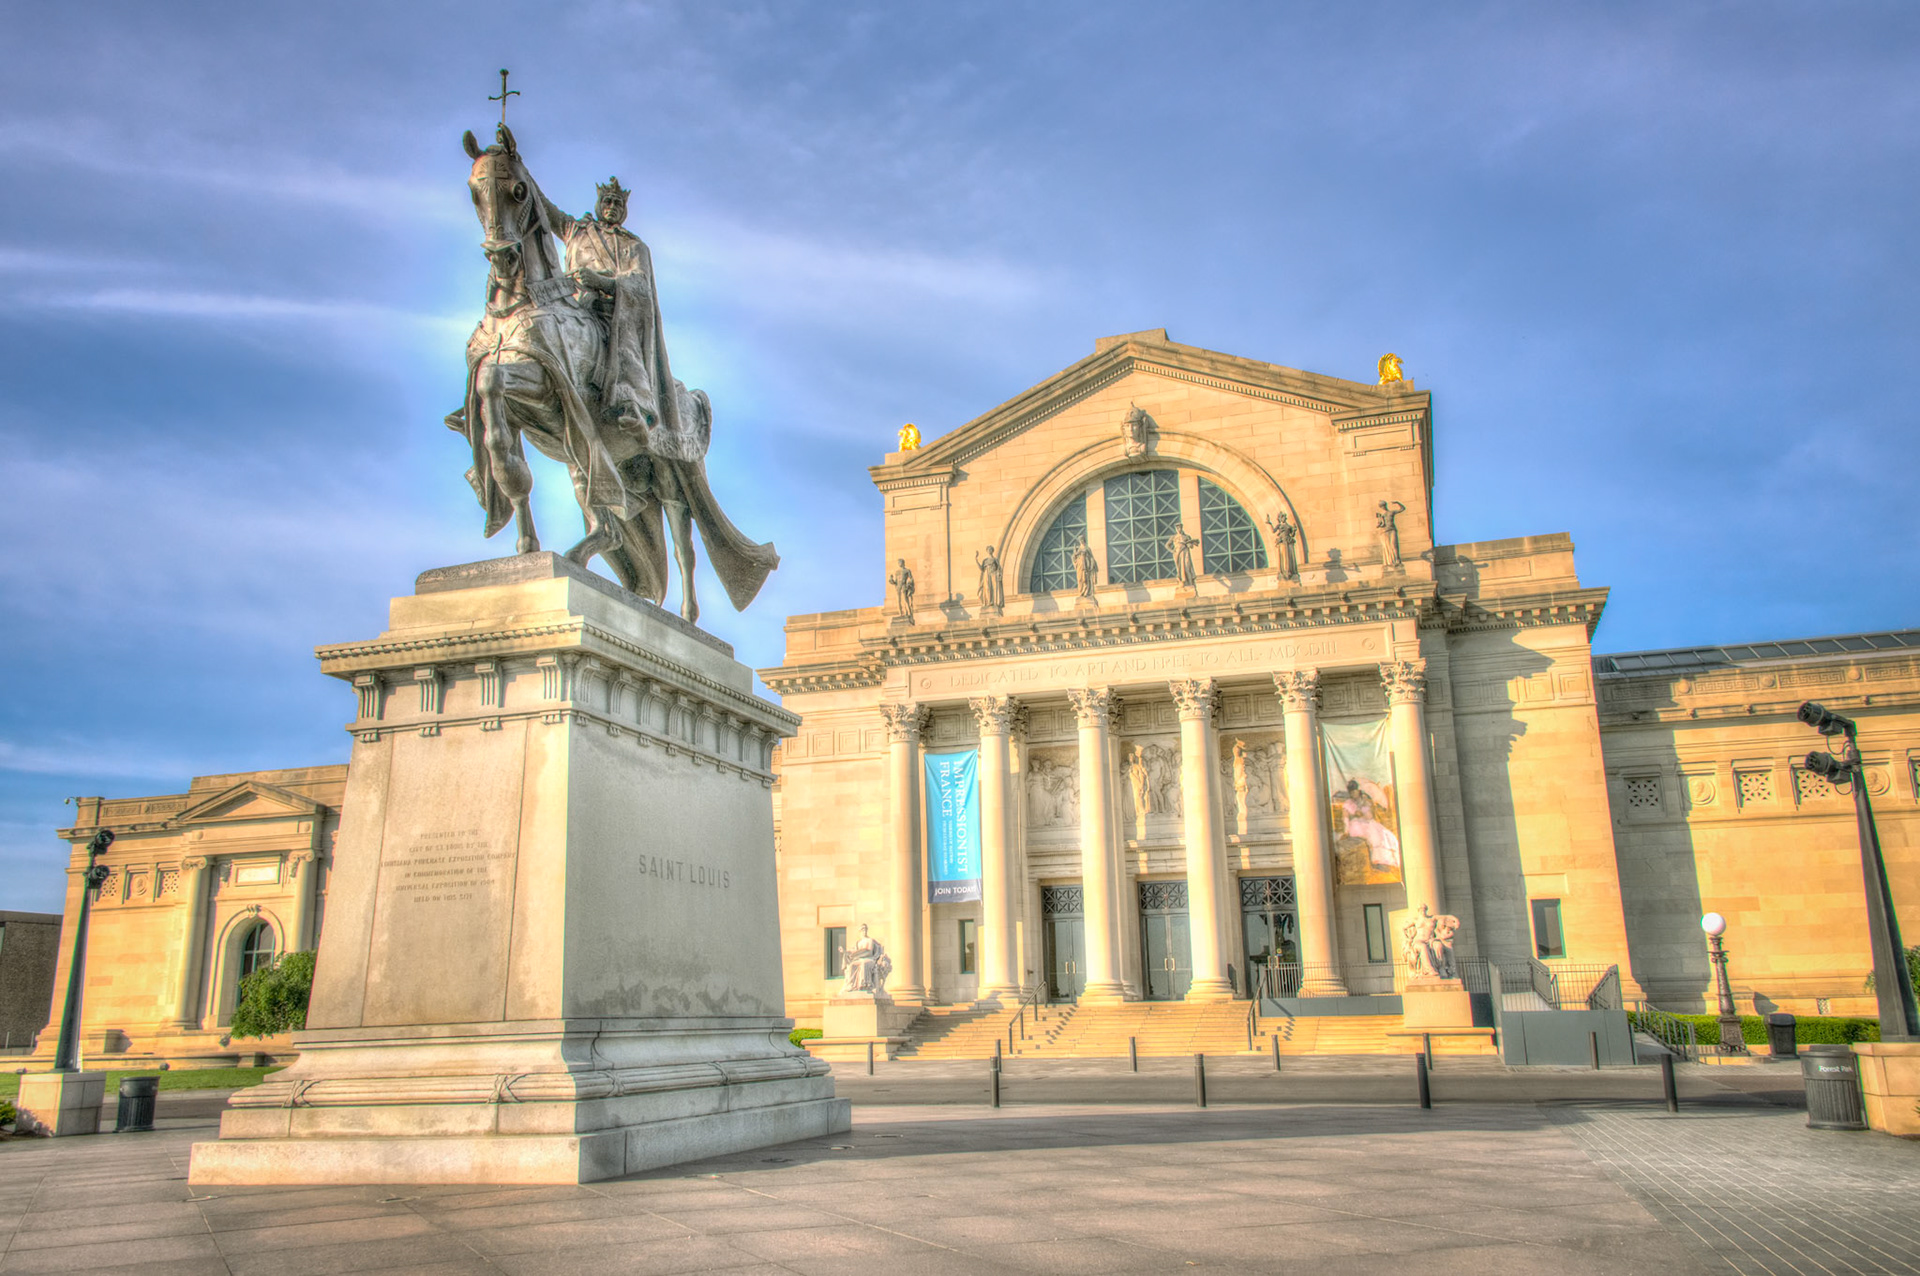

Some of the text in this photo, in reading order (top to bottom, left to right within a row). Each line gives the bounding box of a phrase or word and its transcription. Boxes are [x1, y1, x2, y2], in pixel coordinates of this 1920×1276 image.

[950, 668, 1038, 687] DEDICATED
[1048, 665, 1068, 678] TO
[1075, 661, 1107, 676] ART
[1112, 658, 1147, 674] AND
[1153, 654, 1191, 670] FREE
[1198, 651, 1219, 665] TO
[1226, 648, 1259, 663] ALL
[939, 761, 953, 817] FRANCE
[953, 760, 968, 873] IMPRESSIONIST
[449, 855, 484, 863] EXPOSITION
[487, 852, 516, 860] COMPANY
[639, 854, 730, 889] SAINT LOUIS
[432, 881, 467, 889] EXPOSITION
[935, 887, 951, 896] JOIN
[1818, 1065, 1841, 1073] Forest
